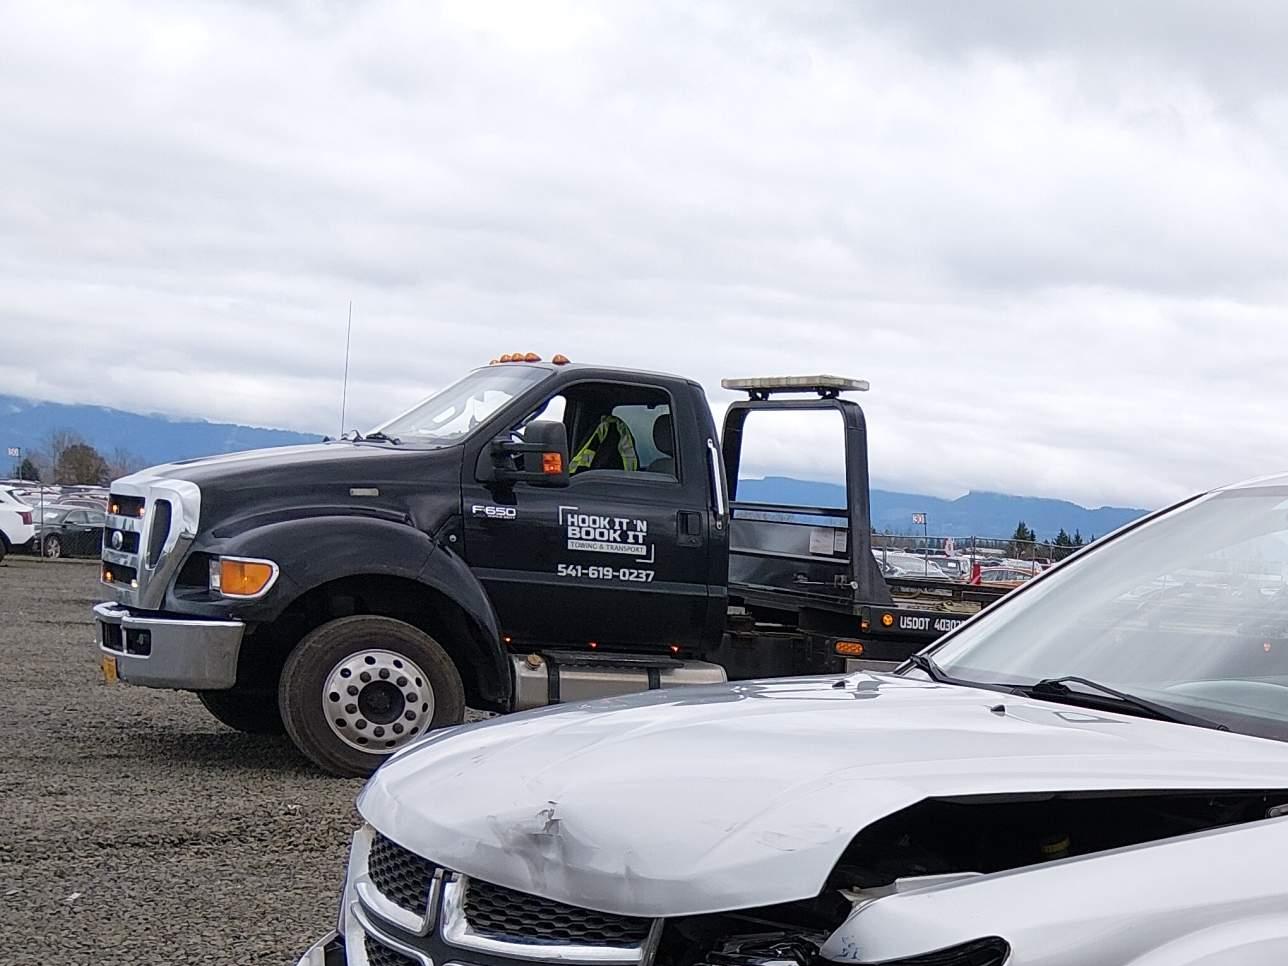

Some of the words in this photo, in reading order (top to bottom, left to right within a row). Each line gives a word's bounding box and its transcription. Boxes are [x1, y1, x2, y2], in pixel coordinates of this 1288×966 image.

[567, 513, 610, 529] HOOK
[613, 517, 630, 531] IT
[567, 526, 622, 542] BOOK
[626, 531, 647, 544] IT
[570, 541, 598, 550] TOWING
[606, 543, 645, 553] TRANSPORT
[557, 564, 655, 582] 541-619-0237
[899, 615, 931, 632] USDOT
